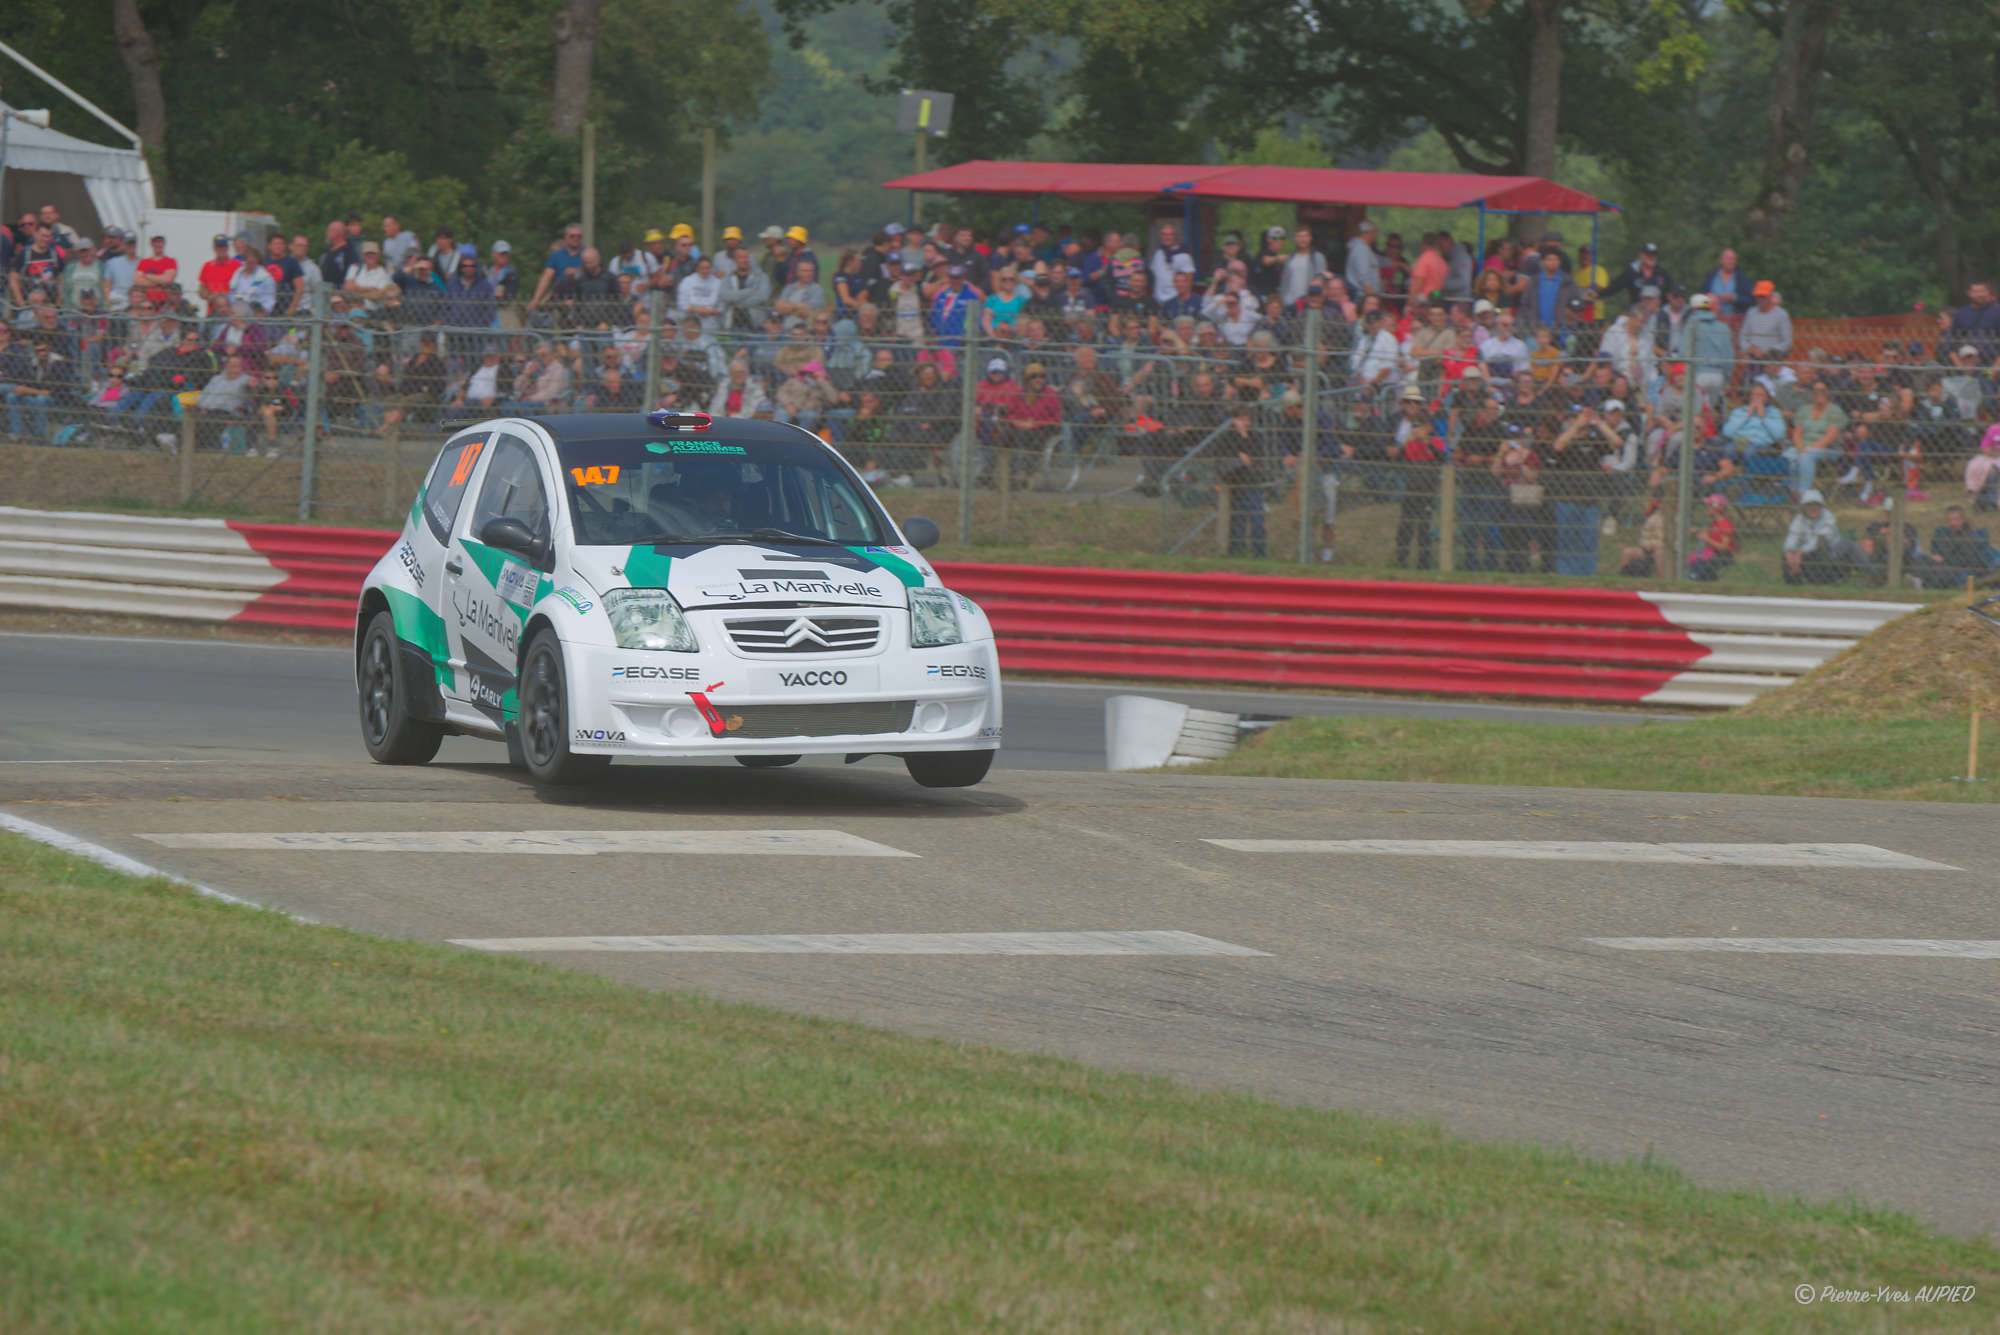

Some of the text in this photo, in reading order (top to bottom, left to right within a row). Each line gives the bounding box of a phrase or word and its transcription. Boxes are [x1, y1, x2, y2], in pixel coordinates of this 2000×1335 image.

[571, 465, 620, 487] 147
[739, 581, 882, 597] La Manivelle
[466, 590, 477, 624] La
[479, 600, 520, 653] Manivell
[612, 667, 700, 680] PEGASE
[779, 671, 848, 686] YACCO
[480, 685, 502, 708] CARLY
[580, 730, 626, 741] NOVA
